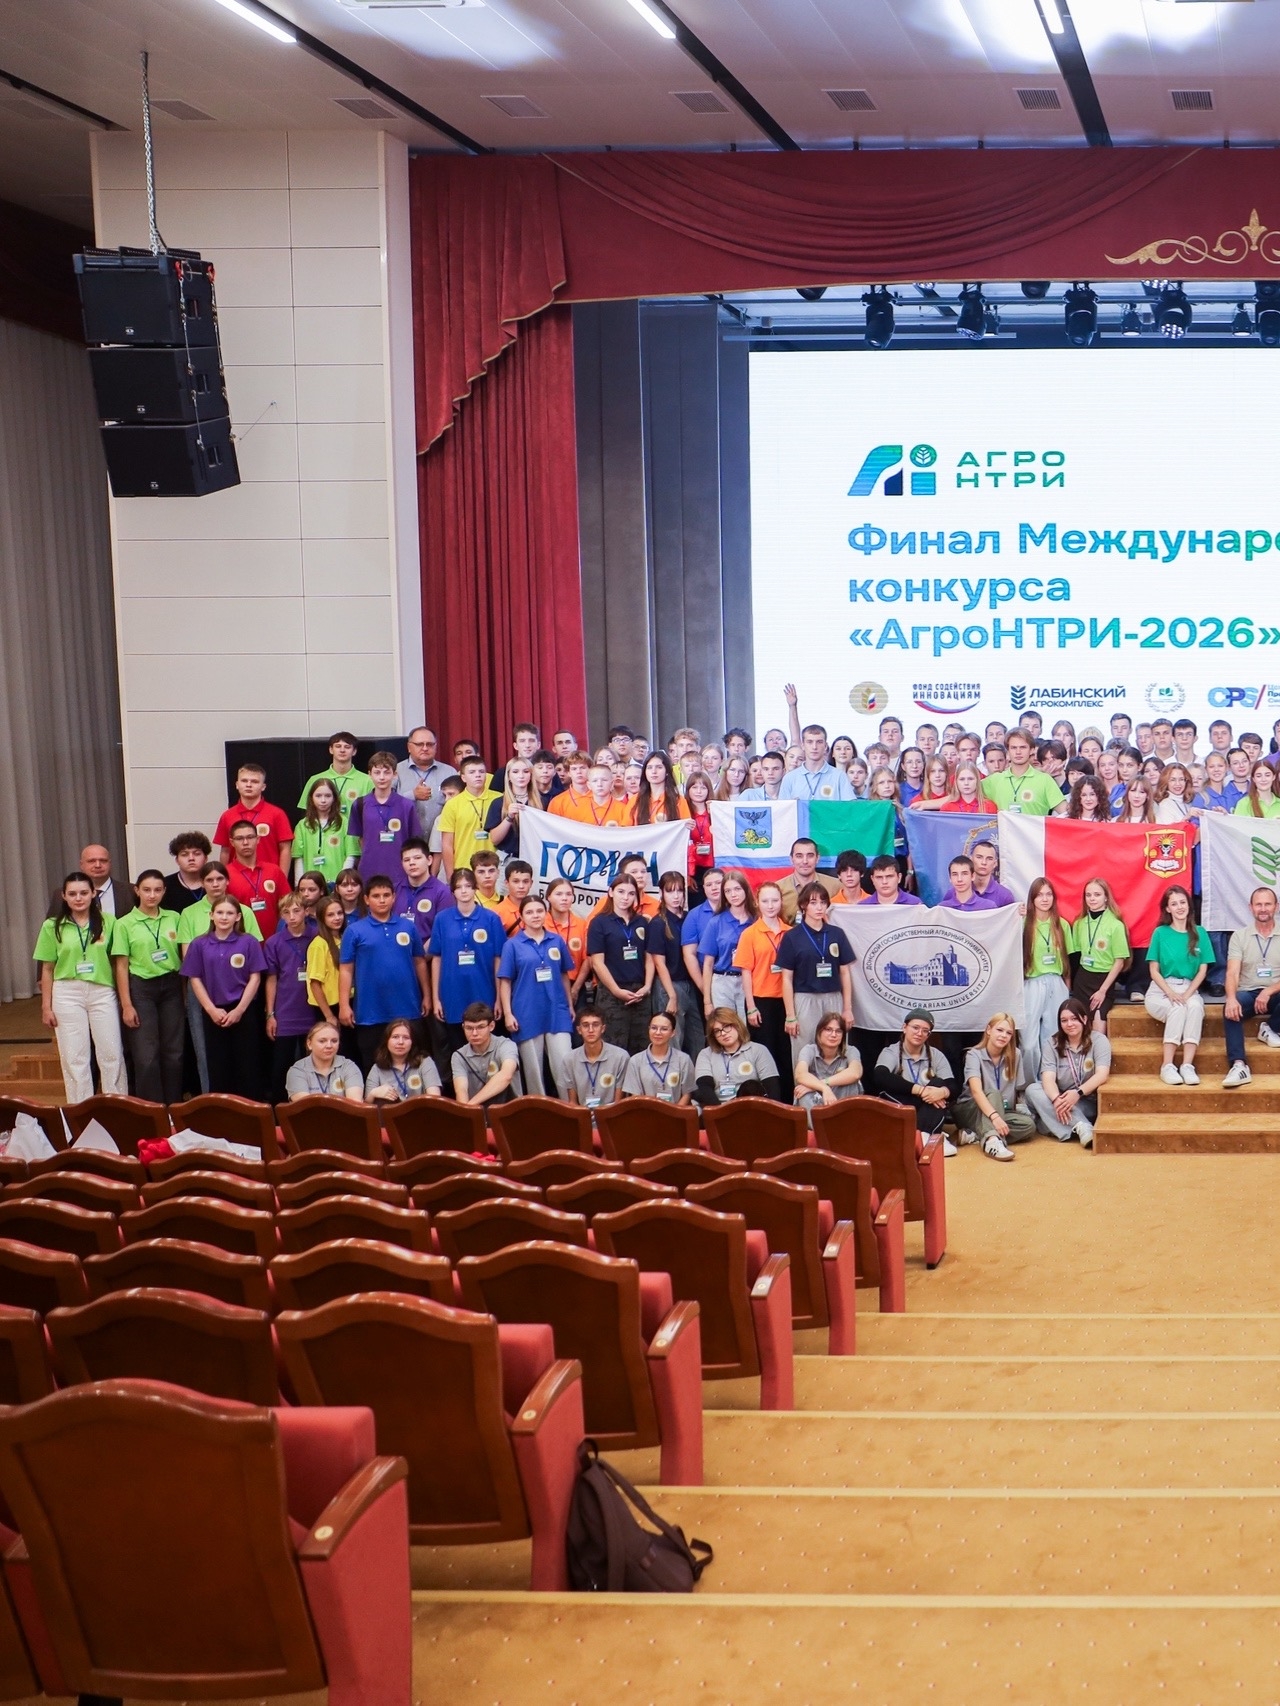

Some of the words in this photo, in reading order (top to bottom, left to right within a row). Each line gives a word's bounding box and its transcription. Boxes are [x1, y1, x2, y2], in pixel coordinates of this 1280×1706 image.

[956, 450, 1066, 468] АГРО
[956, 472, 1065, 488] НТРИ
[848, 523, 1000, 556] Финал
[849, 577, 1071, 612] конкурса
[912, 683, 933, 691] ФОНД
[935, 682, 981, 691] СОДЕЙСТВИЯ
[1029, 685, 1126, 698] ЛАБИНСКИЙ
[912, 691, 981, 701] ИННОВАЦИЯМ
[1029, 700, 1104, 708] АГРОКОМПЛЕКС
[1207, 687, 1259, 708] CPS
[866, 943, 882, 971] ДОНСКОЙ
[880, 929, 934, 946] ГОСУДАРСТВЕННЫЙ
[935, 929, 965, 942] АГРАРНЫЙ
[963, 939, 989, 973] УНИВЕРСИТЕТ
[869, 978, 883, 993] DON
[884, 991, 904, 1005] STATE
[907, 1001, 946, 1009] AGRARIAN
[948, 979, 986, 1006] UNIVERSITY
